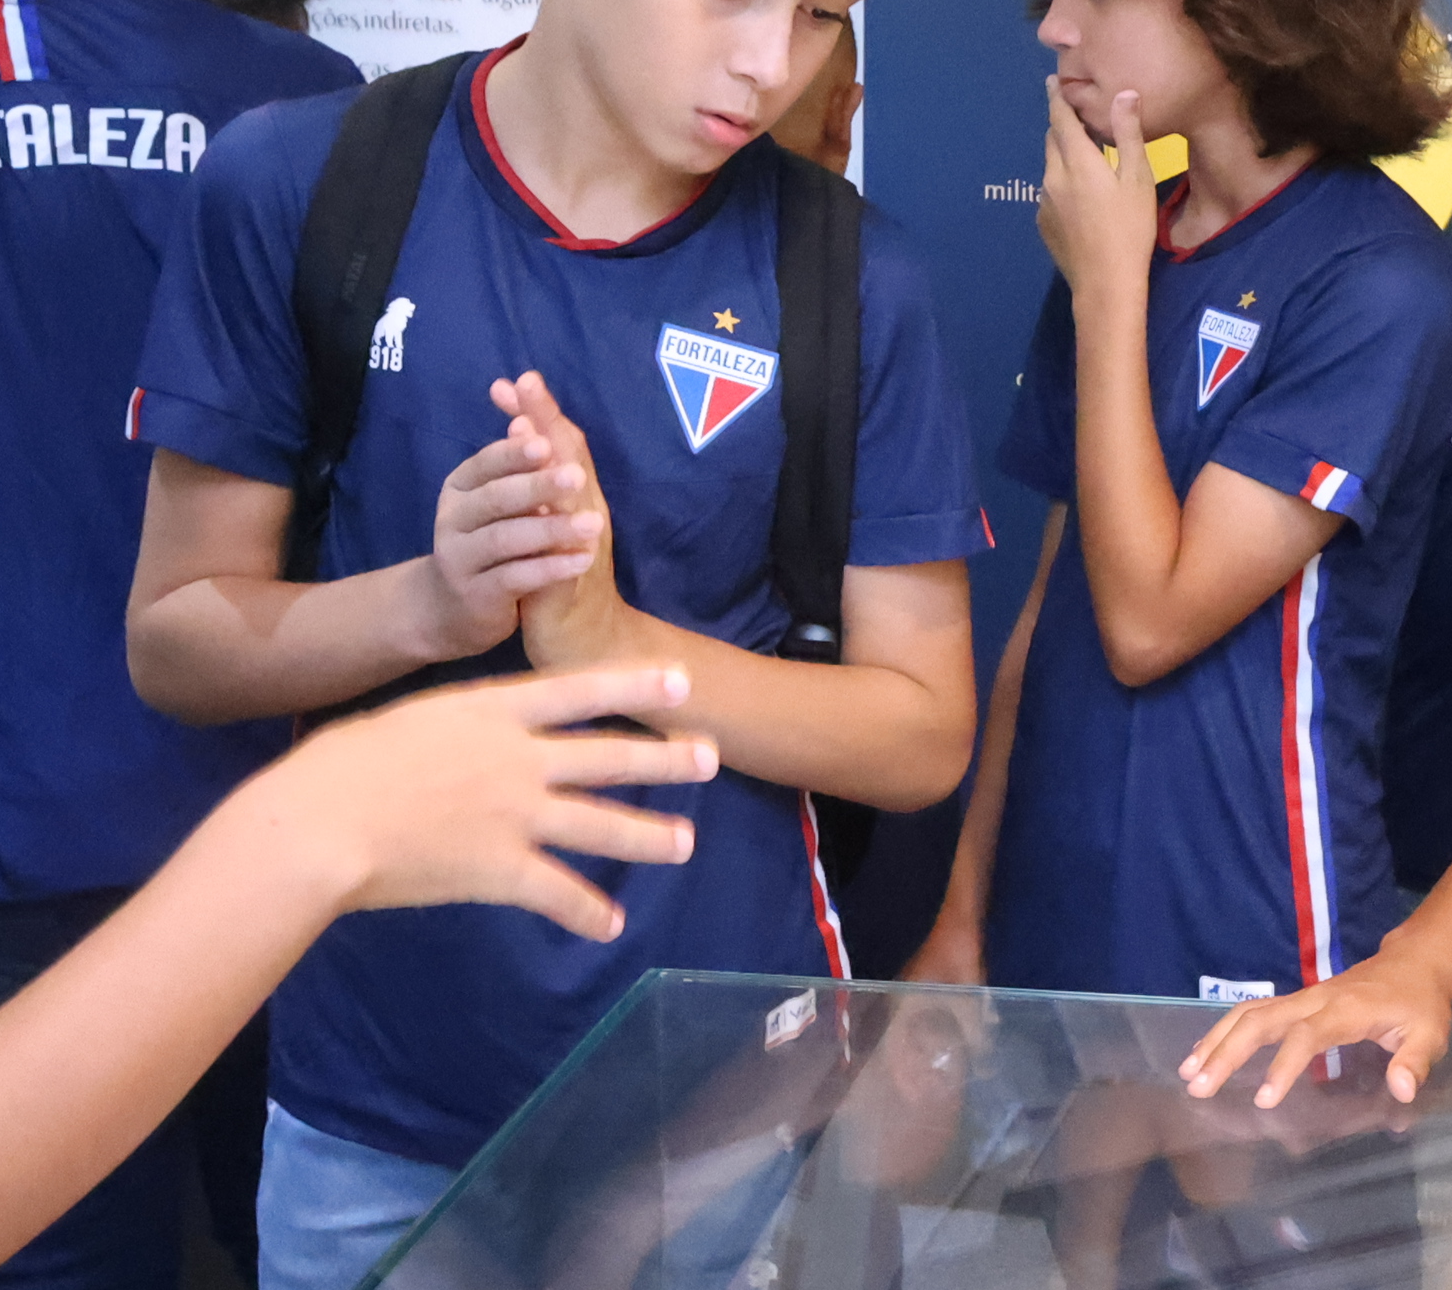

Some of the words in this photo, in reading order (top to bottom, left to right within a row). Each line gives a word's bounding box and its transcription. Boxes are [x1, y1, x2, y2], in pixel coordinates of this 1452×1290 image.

[364, 10, 459, 35] indiretas.
[1201, 314, 1256, 343] FORTALEZA
[369, 345, 404, 372] 918
[664, 334, 769, 379] FORTALEZA
